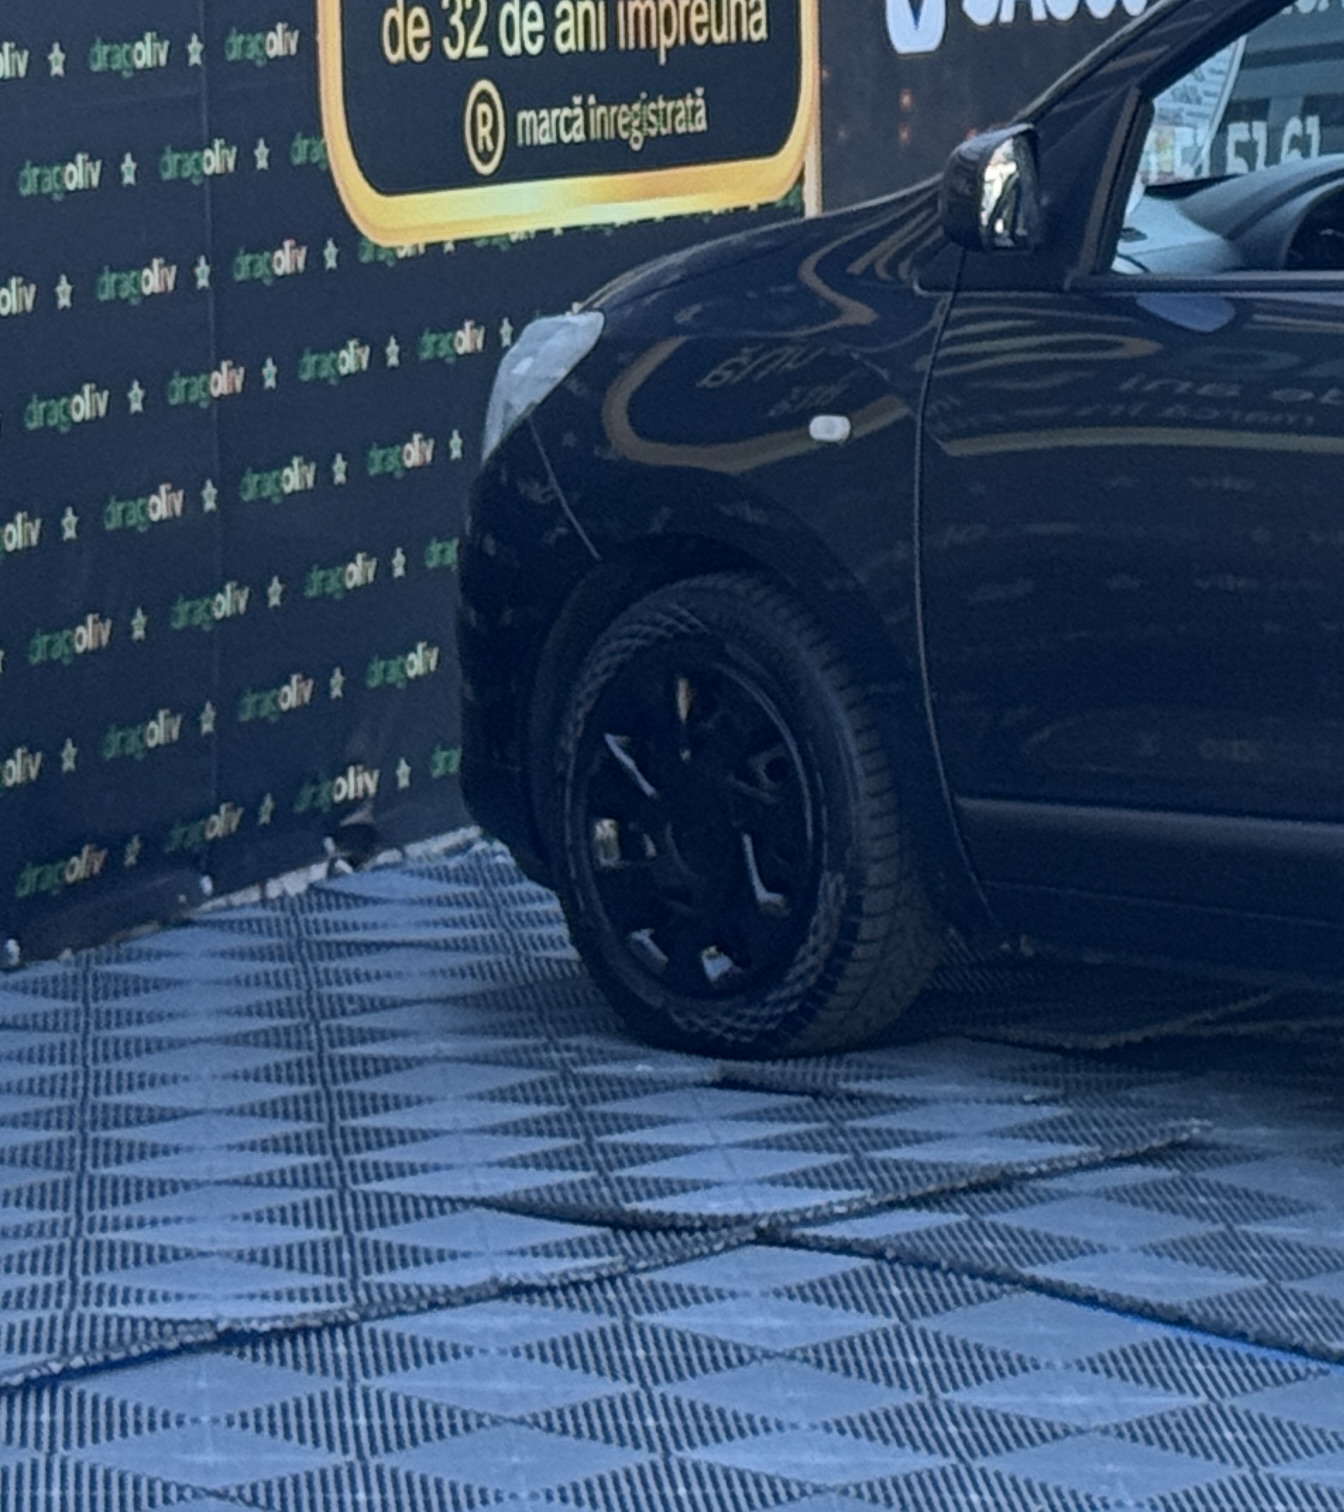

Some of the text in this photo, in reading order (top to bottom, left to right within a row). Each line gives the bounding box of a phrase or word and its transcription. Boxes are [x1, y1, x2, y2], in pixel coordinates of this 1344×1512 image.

[88, 23, 299, 78] dragoliv dragoliv
[516, 98, 585, 149] marcă
[589, 86, 708, 150] înregistrată
[18, 153, 101, 201] dragoliv
[159, 139, 237, 184] dragoliv
[97, 258, 177, 305] dragoliv
[233, 239, 307, 285] dragoliv
[25, 320, 486, 433] dragoliv dragoliv dragoliv dragoliv
[104, 483, 184, 532] dragoliv
[239, 456, 316, 504] dragoliv
[367, 433, 434, 478] dragoliv
[27, 614, 112, 665] dragoliv
[169, 581, 250, 631] dragoliv
[304, 553, 377, 599] dragoliv
[103, 709, 182, 762] dragoliv
[237, 674, 314, 723] dragoliv
[366, 641, 440, 689] dragoliv
